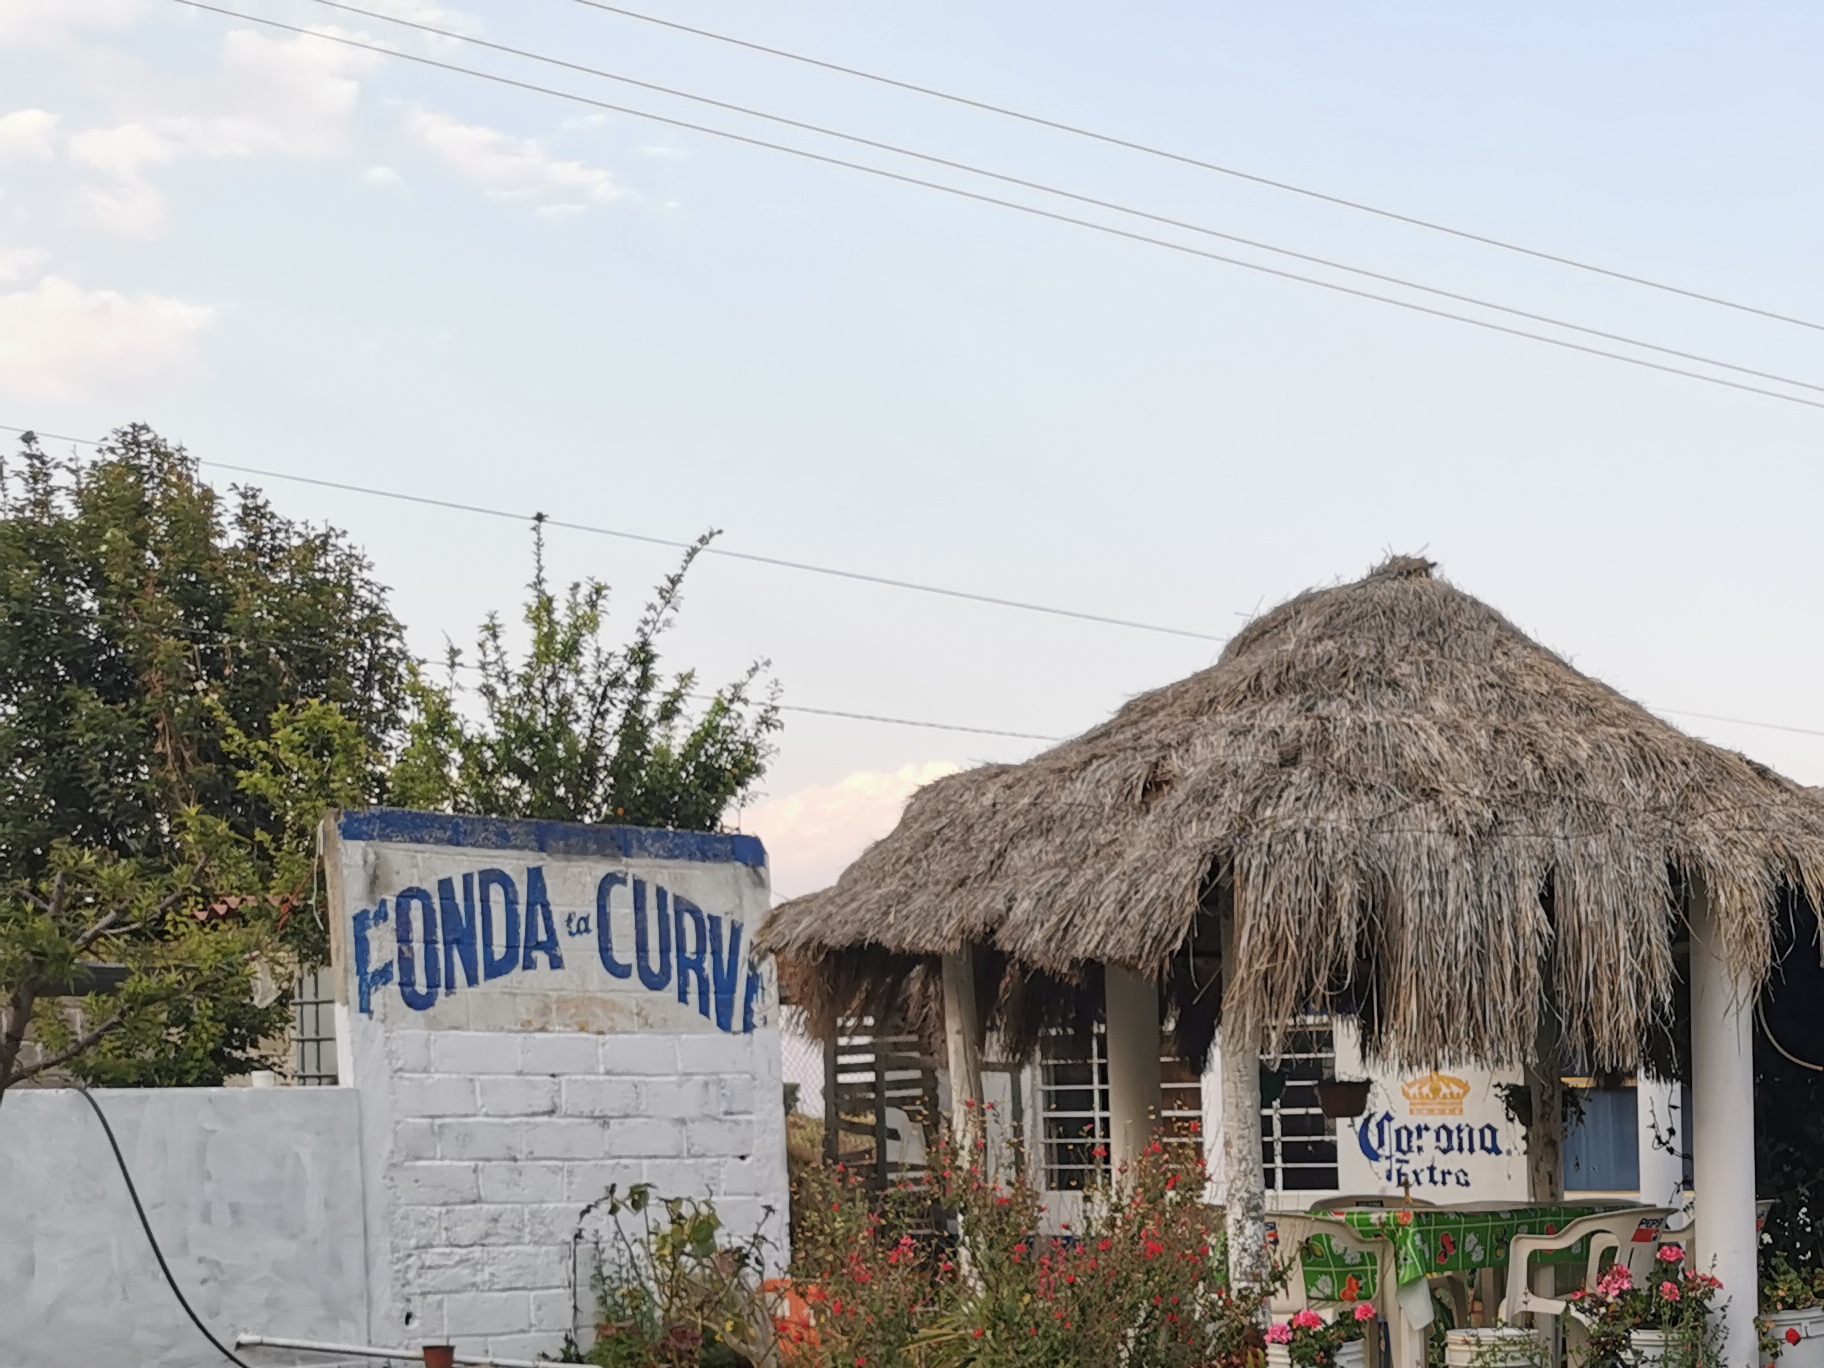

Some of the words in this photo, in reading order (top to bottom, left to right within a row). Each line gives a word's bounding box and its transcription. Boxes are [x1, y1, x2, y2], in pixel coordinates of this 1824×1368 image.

[351, 865, 565, 1015] FONDA
[1358, 1110, 1503, 1163] Corona
[1385, 1155, 1471, 1188] Extra
